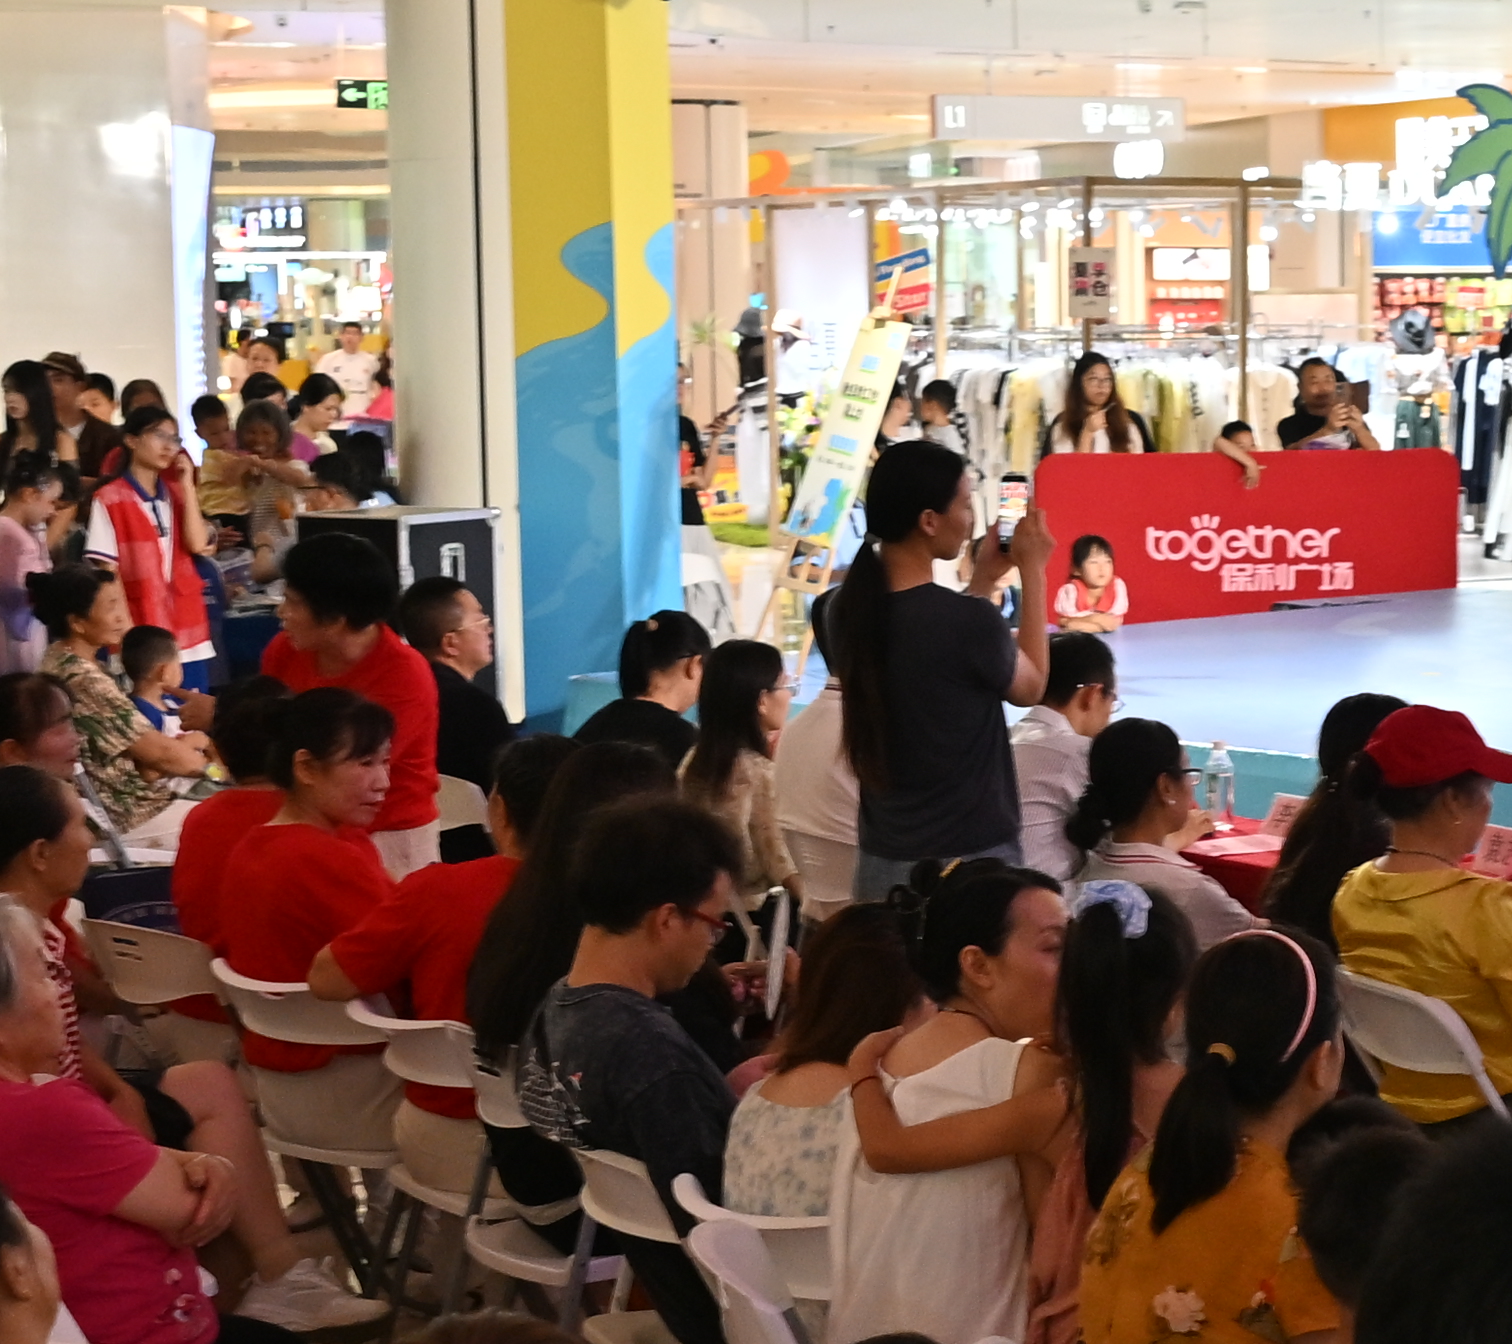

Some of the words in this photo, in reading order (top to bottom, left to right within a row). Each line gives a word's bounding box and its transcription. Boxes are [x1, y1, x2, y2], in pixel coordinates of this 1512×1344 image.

[1145, 522, 1340, 571] together
[1219, 556, 1355, 593] 保利广场
